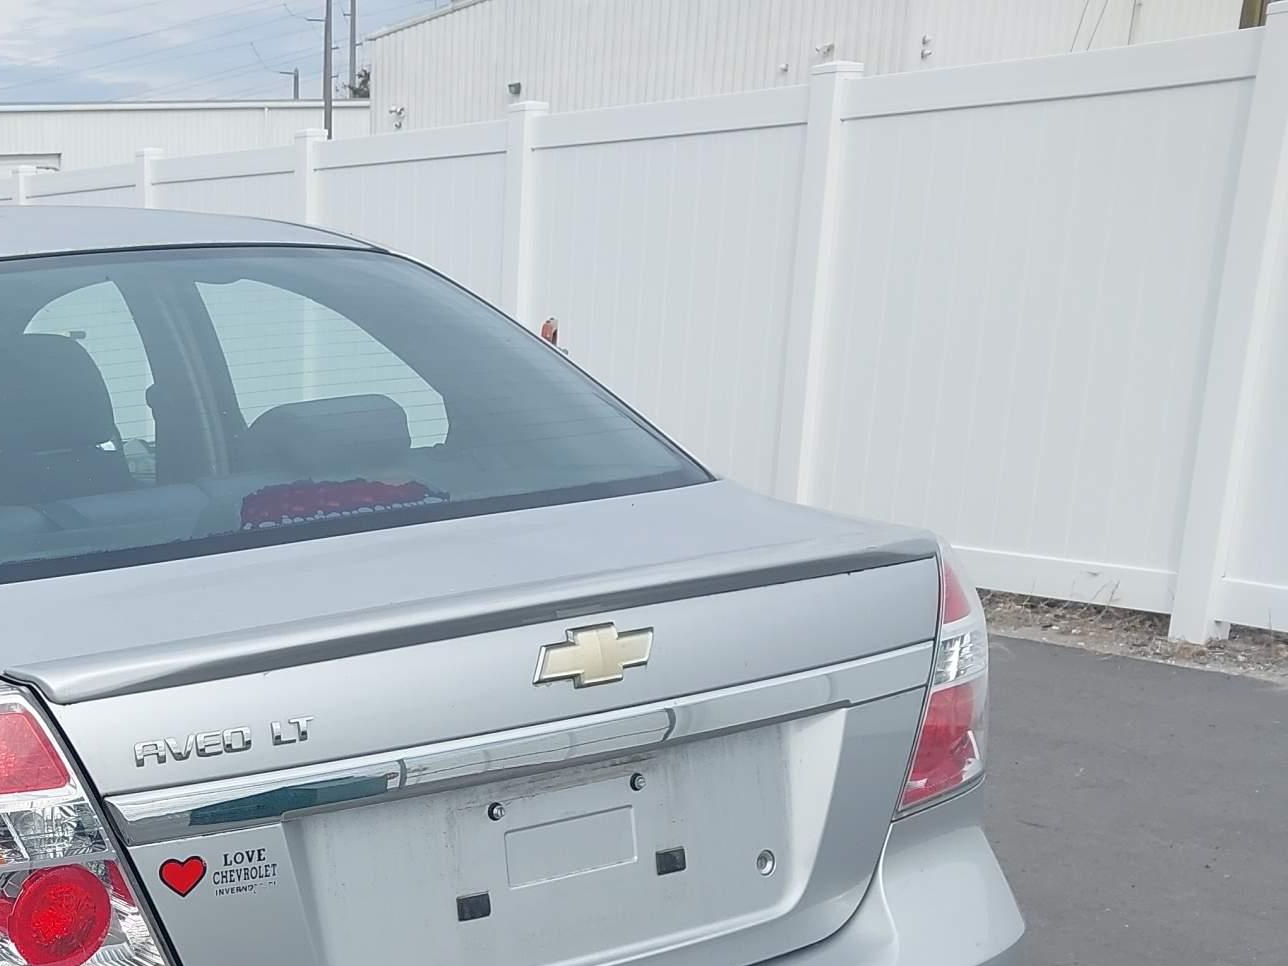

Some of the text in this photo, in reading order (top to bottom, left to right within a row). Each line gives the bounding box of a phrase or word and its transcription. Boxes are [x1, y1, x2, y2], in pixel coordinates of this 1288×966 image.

[133, 715, 315, 768] AVEO LT
[222, 848, 266, 867] LOVE
[213, 863, 278, 886] CHEVROLET
